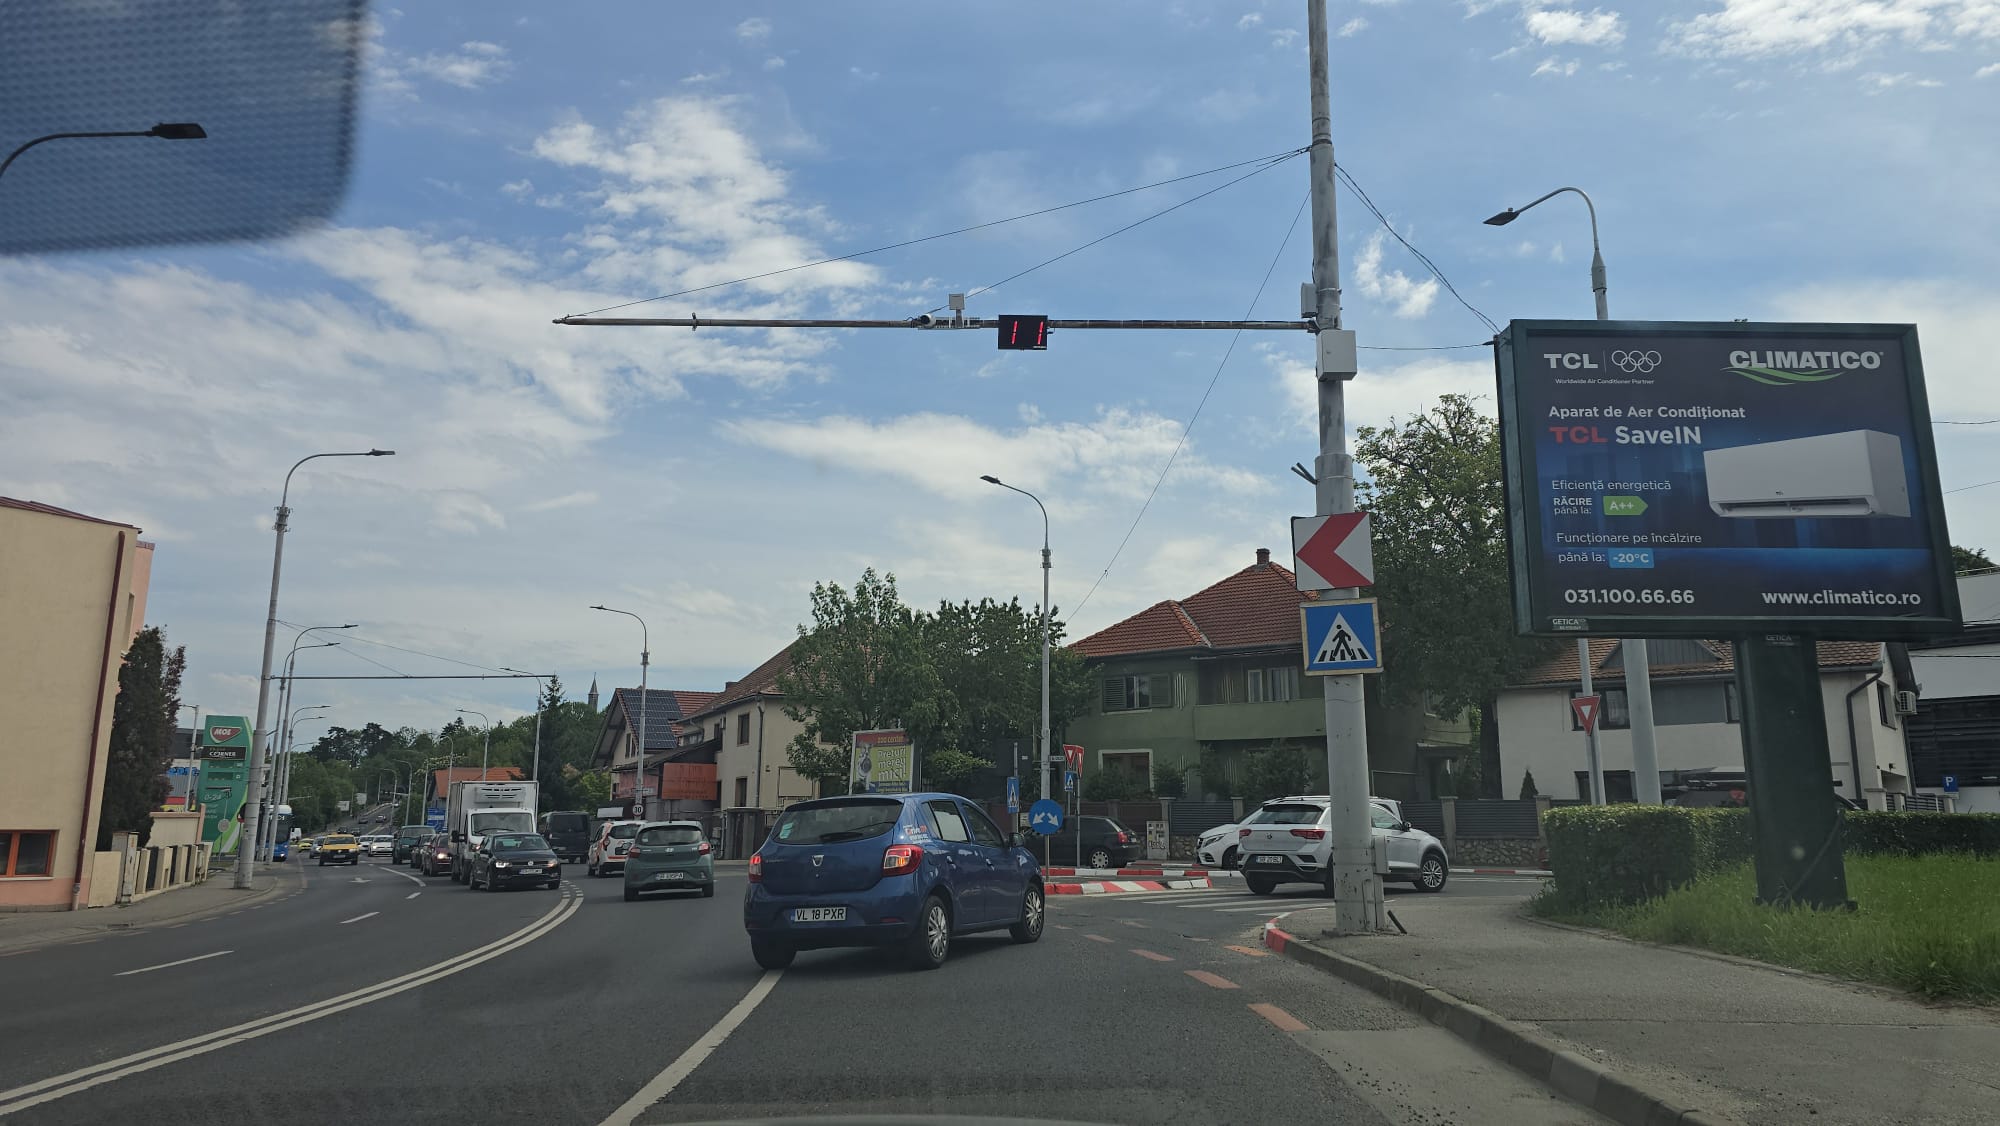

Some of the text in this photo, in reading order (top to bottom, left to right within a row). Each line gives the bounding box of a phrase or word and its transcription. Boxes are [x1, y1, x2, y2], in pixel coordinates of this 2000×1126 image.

[1011, 320, 1044, 345] 11
[1543, 353, 1599, 369] TCL
[1729, 350, 1881, 369] CLIMATICO
[1549, 406, 1599, 419] Aparat
[1603, 405, 1622, 417] de
[1628, 406, 1653, 418] Aer
[1549, 425, 1702, 445] TCL SaveIN
[1607, 480, 1672, 492] energetică
[1553, 495, 1593, 506] RĂCIRE
[1609, 501, 1635, 511] A++
[1580, 505, 1592, 514] la:
[1633, 535, 1649, 545] pe
[1651, 532, 1702, 543] încălzire
[1558, 551, 1649, 564] până la: -20°C
[1564, 588, 1695, 604] 031.100.66.66
[1761, 589, 1921, 605] www.climatico.ro
[213, 728, 231, 736] MOL
[1945, 776, 1954, 787] P
[796, 908, 845, 921] VL 18 PXR
